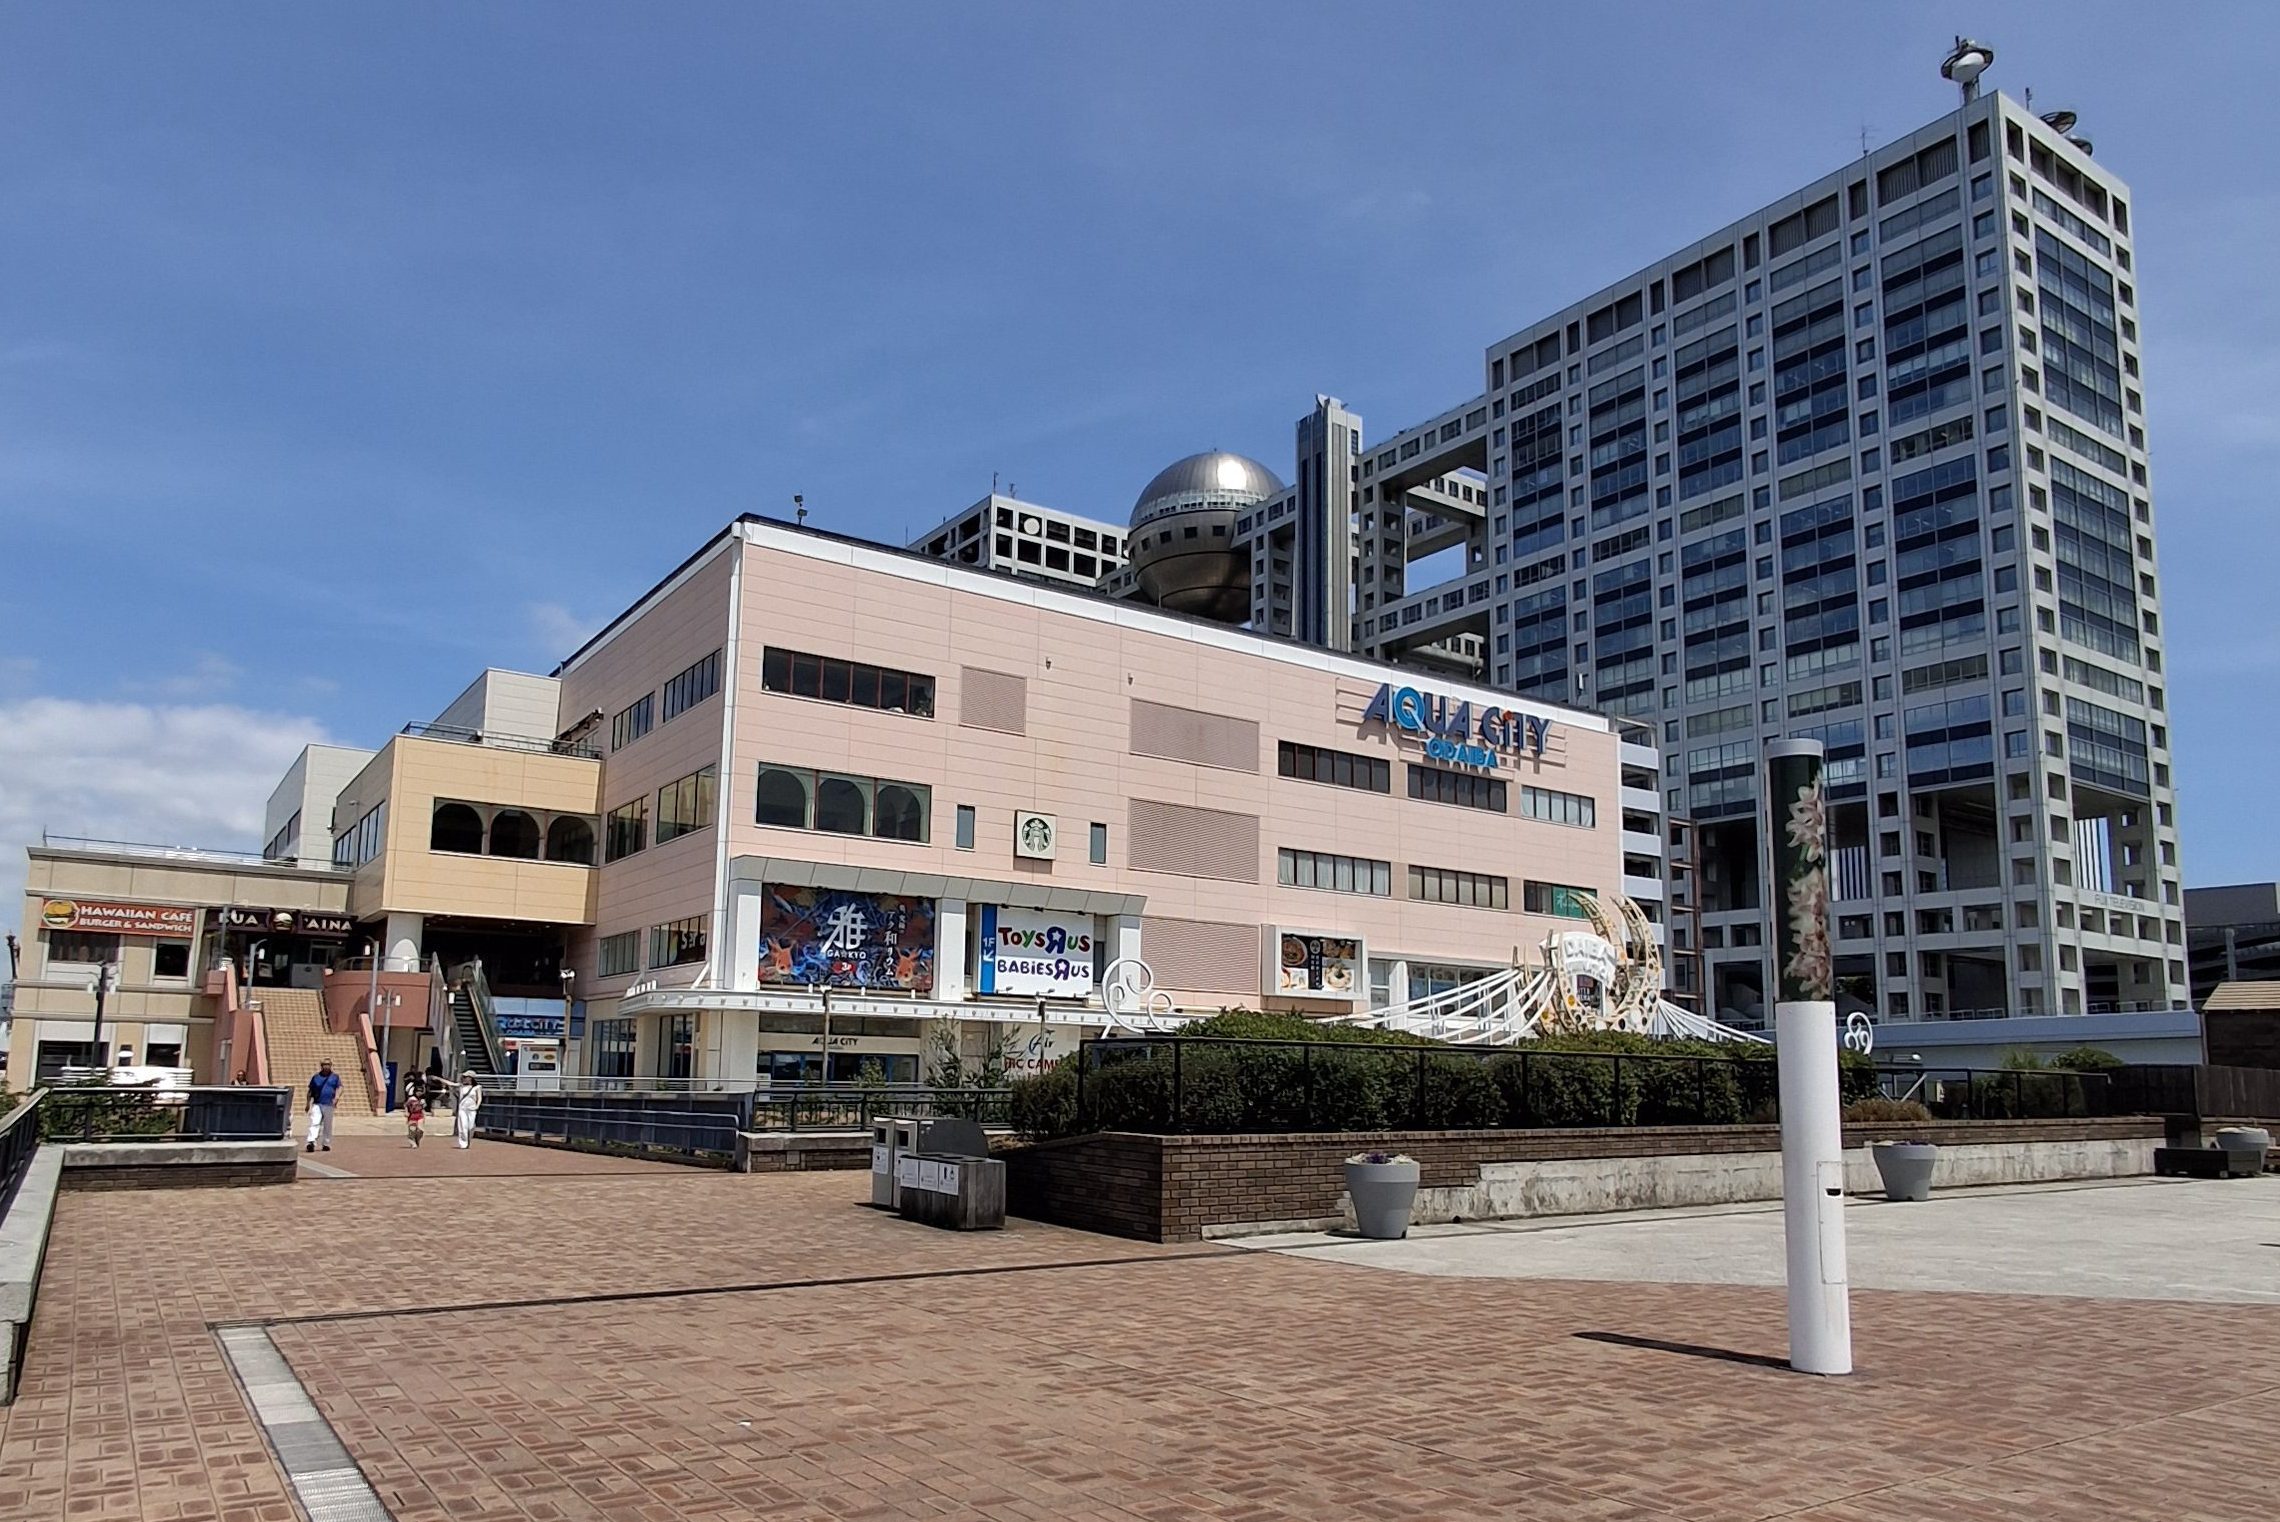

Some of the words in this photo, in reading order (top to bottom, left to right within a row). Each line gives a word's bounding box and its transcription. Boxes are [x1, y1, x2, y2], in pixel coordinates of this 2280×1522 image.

[1362, 682, 1473, 739] AQUA
[1426, 737, 1499, 768] ODAIBA
[80, 905, 156, 920] HAWAIIAN
[79, 918, 123, 928] BURGER
[123, 920, 132, 929] &
[135, 922, 192, 933] SANDWICH
[983, 937, 995, 948] 1F
